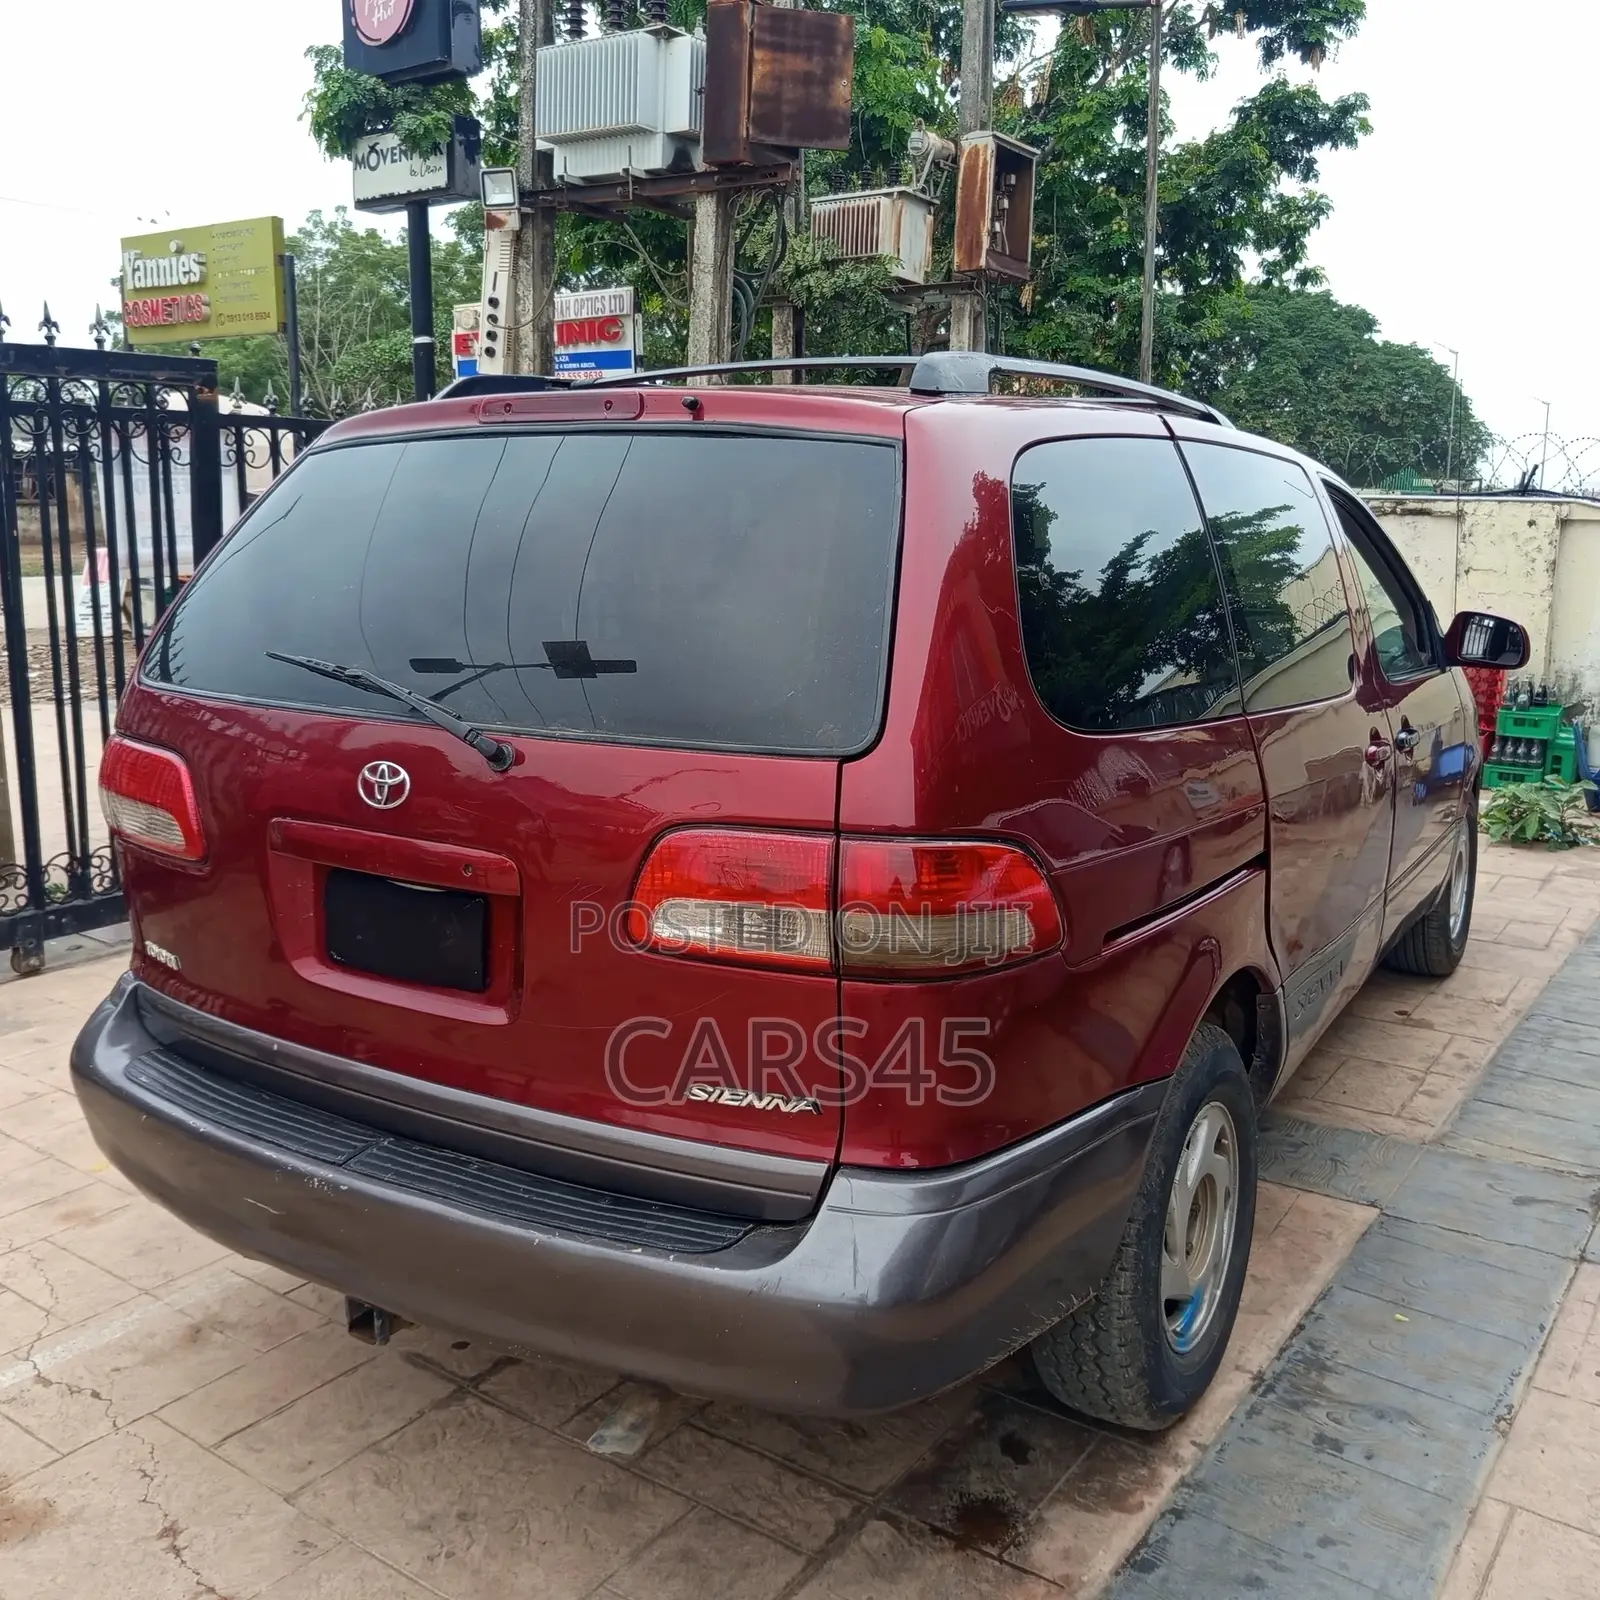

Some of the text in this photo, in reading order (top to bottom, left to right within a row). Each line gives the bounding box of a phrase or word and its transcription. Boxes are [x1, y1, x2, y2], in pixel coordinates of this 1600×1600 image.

[123, 239, 204, 290] Yannies
[123, 294, 207, 328] COSMETICS
[573, 295, 606, 317] OPTICS
[609, 294, 624, 313] LTD
[685, 1083, 823, 1115] SIENNA
